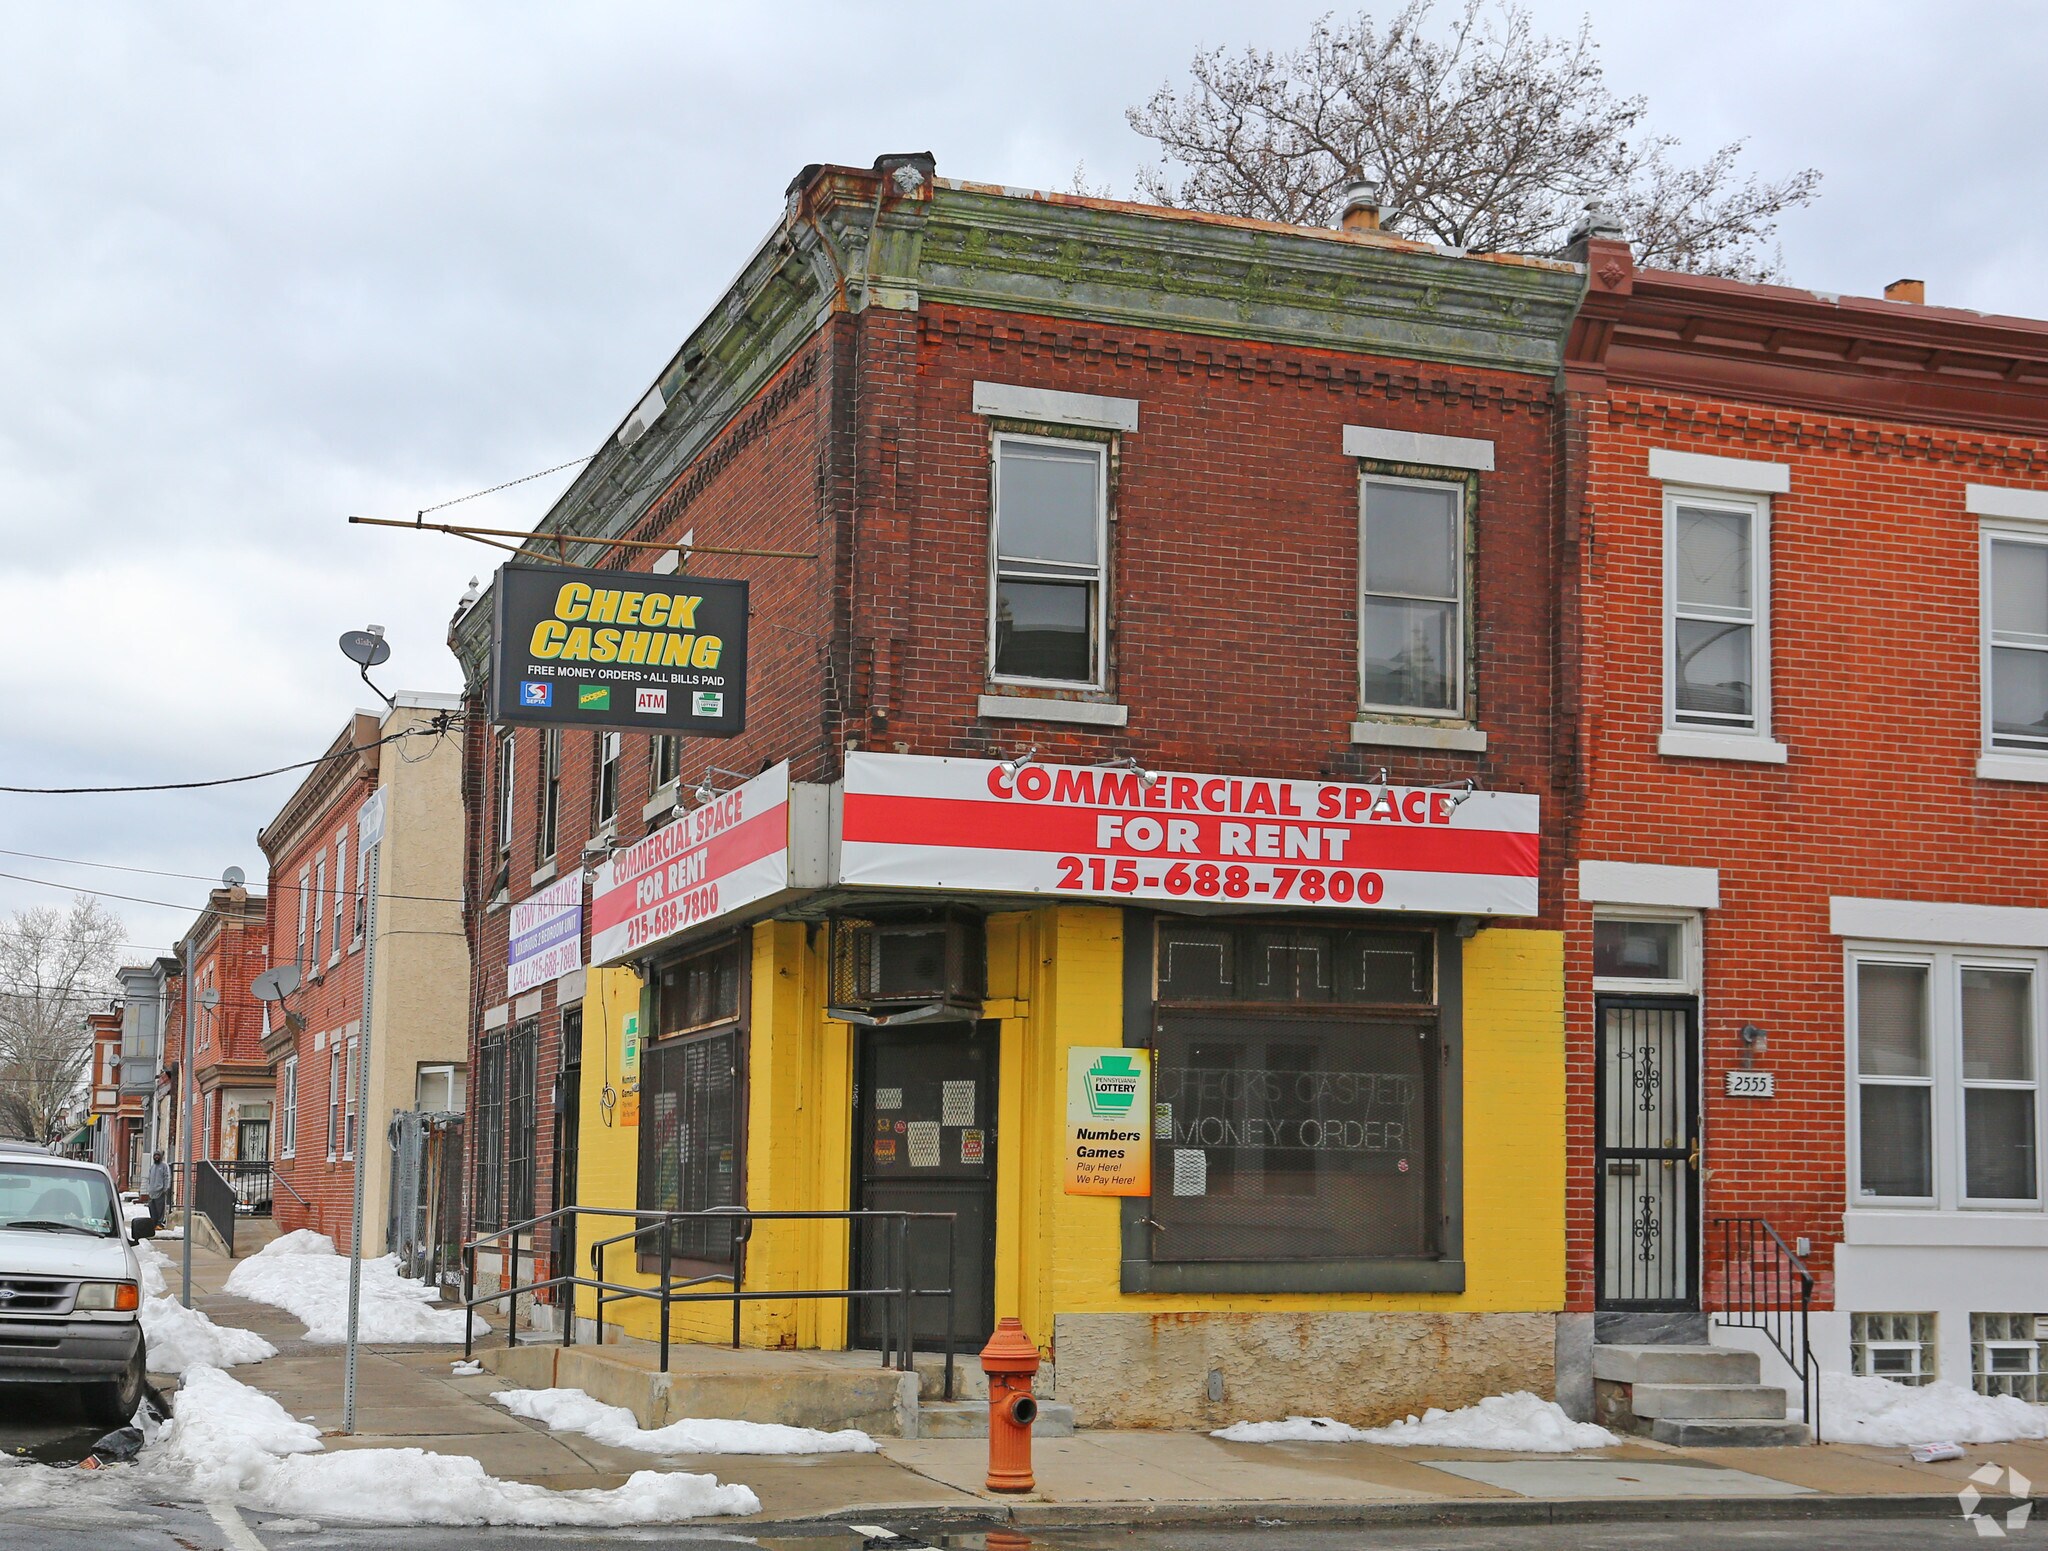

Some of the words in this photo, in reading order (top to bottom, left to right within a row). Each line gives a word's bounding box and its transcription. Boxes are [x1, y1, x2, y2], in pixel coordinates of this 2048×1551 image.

[554, 582, 703, 629] CHECK
[529, 619, 723, 669] CASHING
[527, 665, 555, 676] FREE
[557, 667, 596, 679] MONEY
[598, 669, 641, 681] ORDERS
[649, 672, 669, 683] ALL
[671, 673, 699, 685] BILLS
[701, 675, 725, 686] PAID
[638, 693, 665, 709] ATM
[987, 765, 1301, 816] COMMERCIAL
[1316, 786, 1450, 825] SPACE
[613, 819, 692, 886] COMMERCIAL
[696, 790, 743, 842] SPACE
[1097, 815, 1201, 854] FOR
[1219, 821, 1351, 861] RENT
[636, 870, 664, 910] FOR
[668, 847, 708, 894] RENT
[1056, 856, 1384, 904] 215-688-7800
[515, 900, 536, 934] NOW
[538, 876, 578, 922] RENTING
[627, 883, 719, 948] 215-688-7800
[513, 963, 530, 991] CALL
[531, 940, 577, 983] 215-688-7800
[1095, 1083, 1136, 1093] LOTTERY
[1159, 1069, 1282, 1103] CHECKS
[1295, 1072, 1416, 1105] CASHED
[1734, 1076, 1767, 1092] 2555
[1076, 1128, 1140, 1141] Numbers
[1076, 1146, 1125, 1159] Games
[1173, 1116, 1285, 1146] MONEY
[1299, 1119, 1405, 1149] ORDER
[1076, 1162, 1095, 1173] Play
[1097, 1162, 1122, 1172] Here!
[1076, 1174, 1091, 1184] We
[1093, 1175, 1110, 1186] Pay
[1111, 1175, 1136, 1185] Here!
